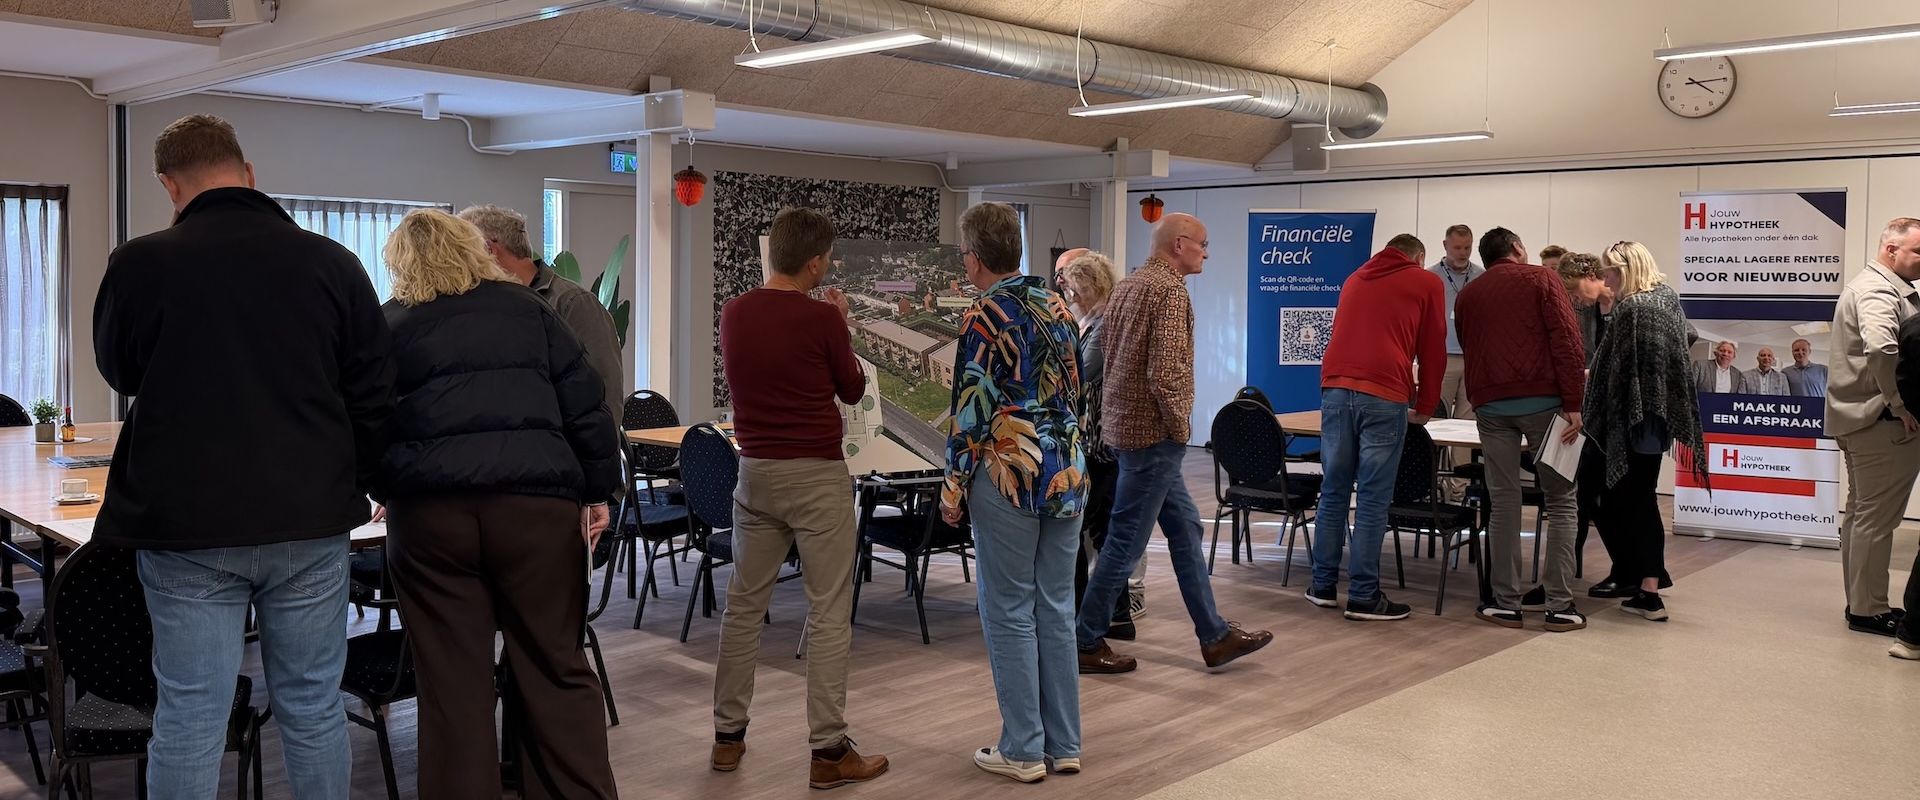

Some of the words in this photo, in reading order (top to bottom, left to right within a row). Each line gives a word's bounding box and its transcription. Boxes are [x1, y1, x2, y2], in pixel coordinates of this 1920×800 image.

[1684, 203, 1705, 229] H
[1710, 210, 1741, 218] Jouw
[1710, 221, 1780, 229] HYPOTHEEK
[1261, 224, 1353, 243] Financiële
[1701, 235, 1752, 243] hypotheken
[1261, 246, 1312, 265] check
[1684, 256, 1741, 264] SPECIAAL
[1794, 255, 1840, 263] RENTES
[1684, 272, 1728, 282] VOOR
[1734, 272, 1840, 282] NIEUWBOUW
[1260, 285, 1279, 293] vraag
[1733, 402, 1776, 413] MAAK
[1780, 404, 1801, 414] NU
[1712, 414, 1739, 425] EEN
[1743, 416, 1822, 428] AFSPRAAK
[1722, 448, 1739, 468] H
[1741, 454, 1763, 462] Jouw
[1741, 463, 1791, 472] HYPOTHEEK
[1678, 504, 1835, 524] www.jouwhypotheek.nl
